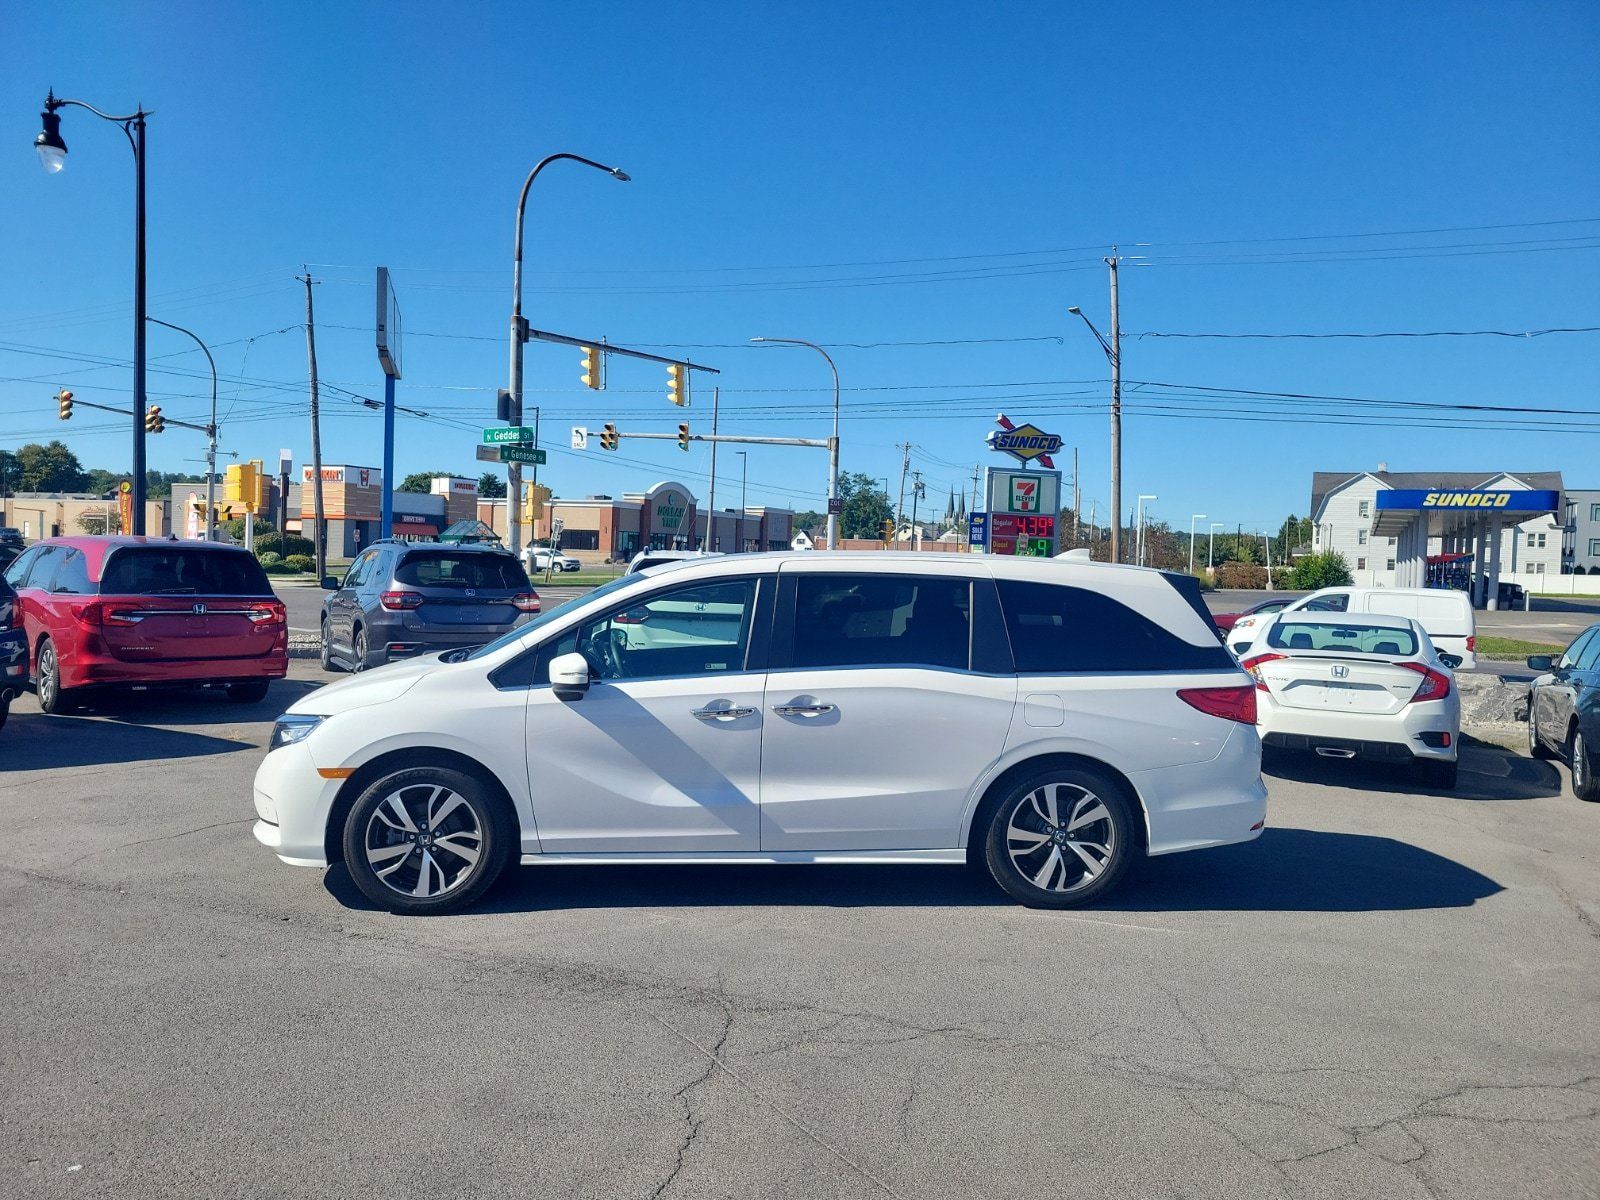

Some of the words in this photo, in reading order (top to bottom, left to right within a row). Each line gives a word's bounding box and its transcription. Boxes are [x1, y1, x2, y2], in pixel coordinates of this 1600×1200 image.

[494, 431, 520, 440] Geddes
[998, 435, 1058, 450] SUNOCO
[511, 449, 537, 461] Genesee
[1423, 493, 1511, 507] SUNOCO
[993, 518, 1013, 527] Regular
